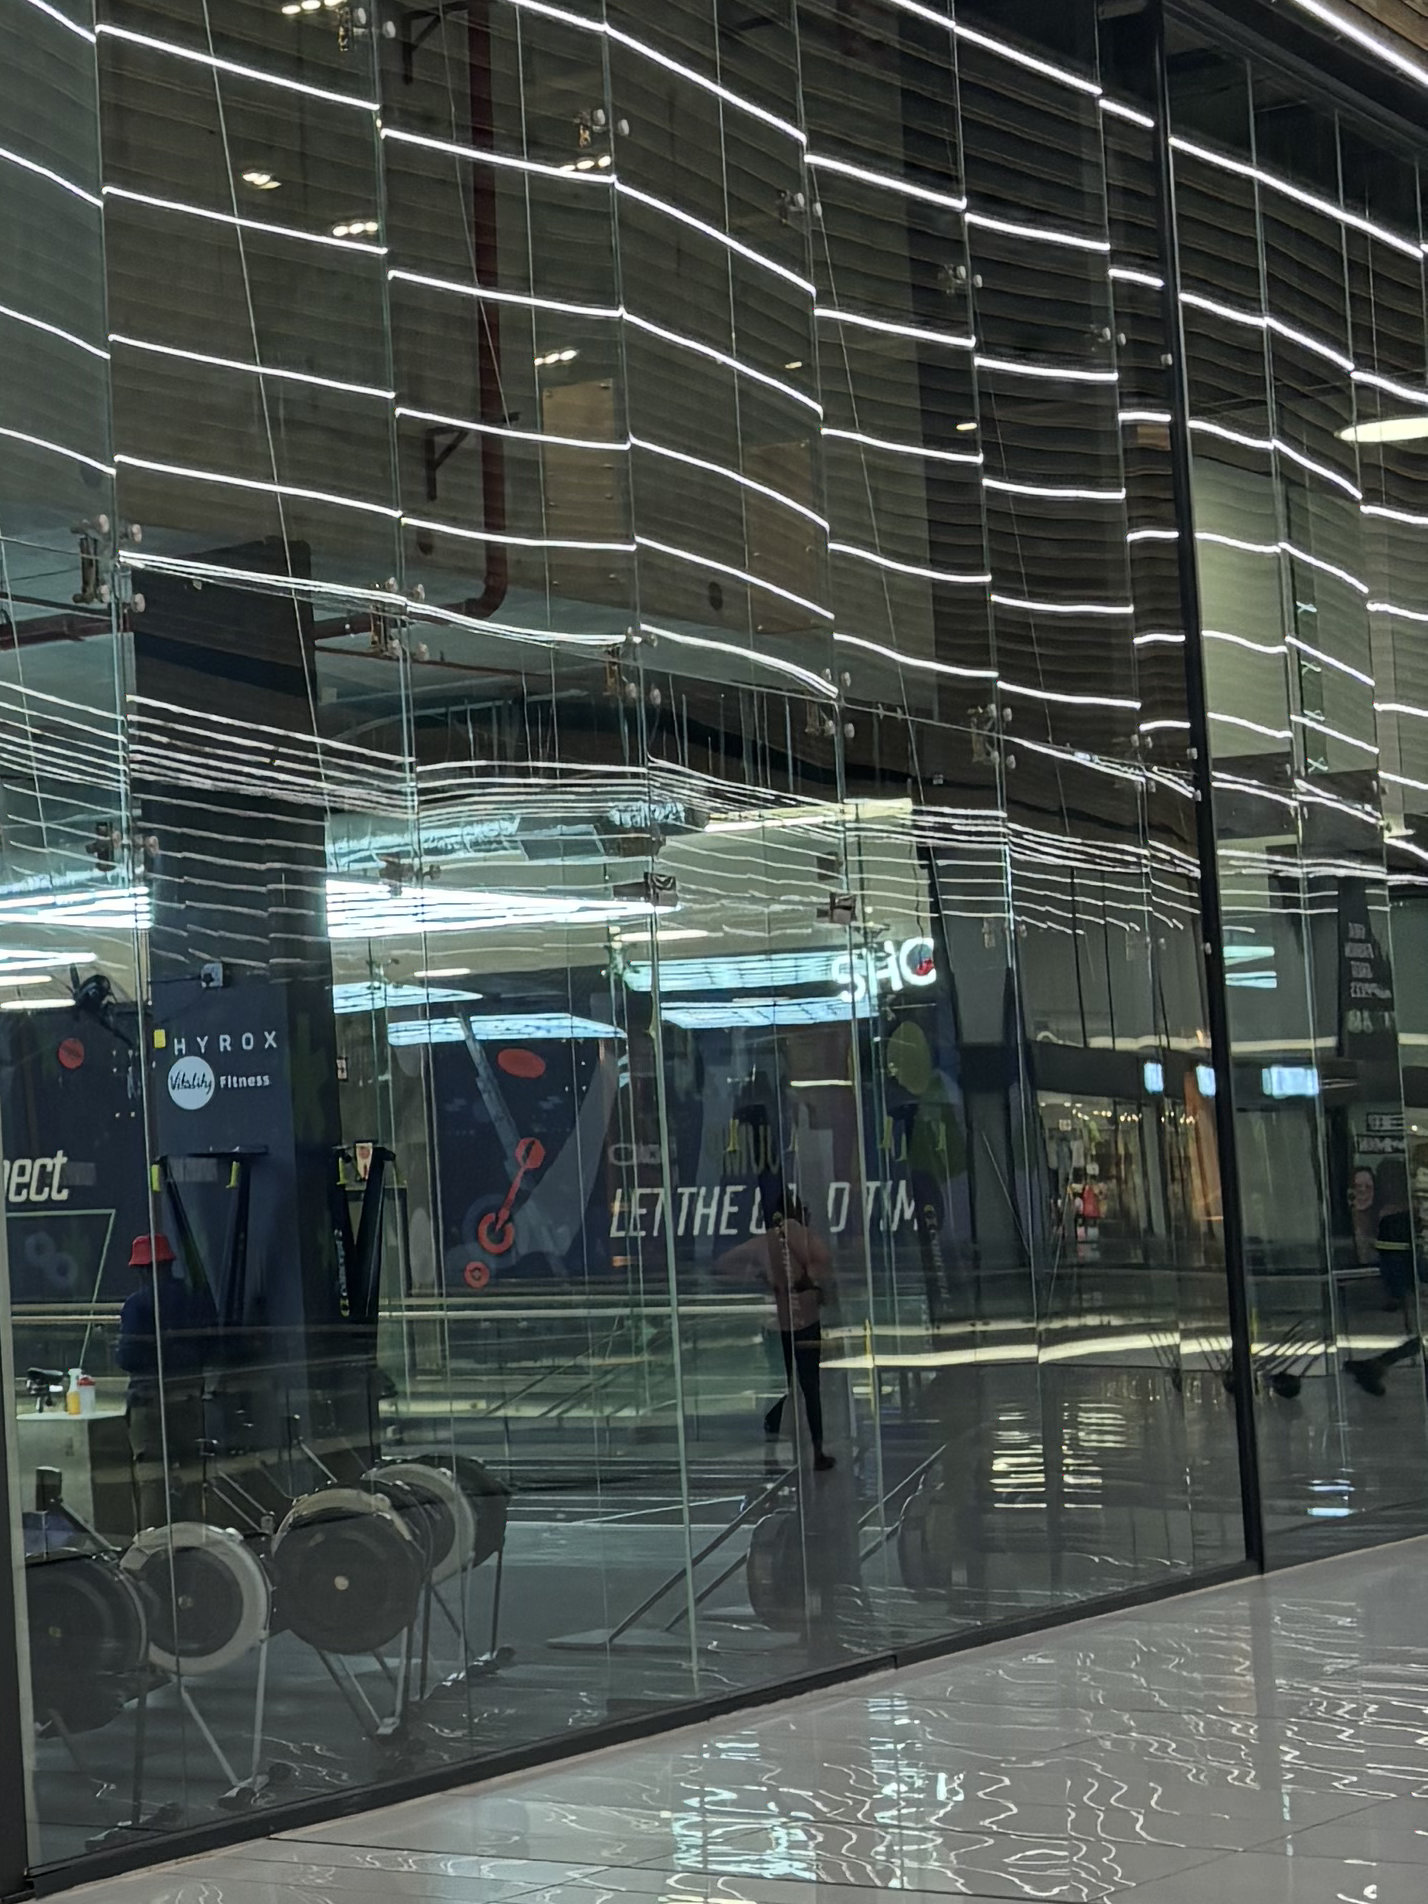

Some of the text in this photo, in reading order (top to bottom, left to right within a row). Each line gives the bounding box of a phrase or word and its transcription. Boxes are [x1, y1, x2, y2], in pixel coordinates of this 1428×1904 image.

[173, 1030, 278, 1056] HYROX
[218, 1073, 271, 1090] Fitness
[676, 1184, 748, 1237] THE
